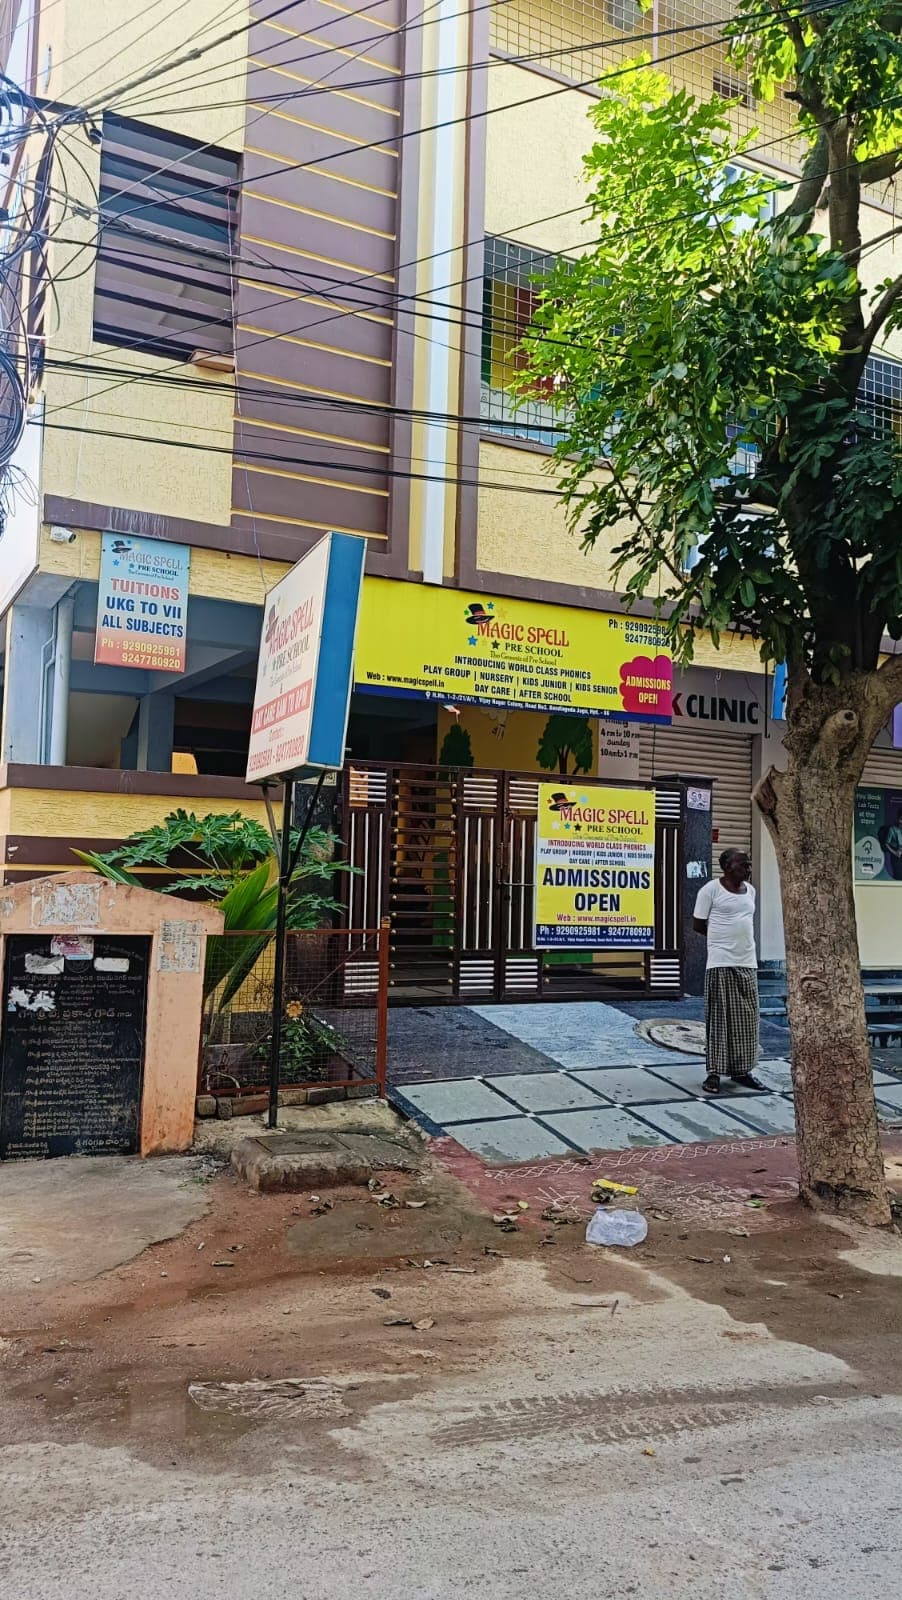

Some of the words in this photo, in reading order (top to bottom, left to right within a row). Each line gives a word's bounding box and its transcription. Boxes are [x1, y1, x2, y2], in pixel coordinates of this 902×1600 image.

[119, 551, 152, 565] MAGIC
[153, 556, 182, 570] SPELL
[138, 564, 151, 572] PRE
[152, 566, 179, 577] SCHOOL
[111, 578, 180, 601] TUITIONS
[106, 596, 135, 612] UKG
[140, 601, 158, 616] TO
[163, 604, 182, 619] VII
[102, 614, 122, 629] ALL
[126, 617, 184, 638] SUBJECTS
[608, 619, 618, 629] Ph
[477, 621, 524, 642] MAGIC
[527, 626, 570, 647] SPELL
[102, 638, 114, 649] Ph
[122, 640, 181, 657] 9290925981
[505, 642, 523, 653] PRE
[525, 645, 564, 658] SCHOOL
[122, 652, 181, 669] 9247780920
[454, 656, 506, 670] INTRODUCING
[508, 662, 534, 674] WORLD
[535, 666, 558, 676] CLASS
[560, 669, 592, 680] PHONICS
[366, 671, 381, 681] Web
[386, 674, 445, 689] www.magicspell.in
[423, 664, 442, 675] PLAY
[444, 667, 471, 679] GROUP
[479, 672, 514, 684] NURSERY
[522, 677, 539, 687] KIDS
[541, 679, 567, 690] JUNIOR
[575, 682, 591, 692] KIDS
[593, 685, 618, 695] SENIOR
[626, 675, 671, 691] ADMISSIONS
[474, 684, 489, 693] DAY
[491, 686, 511, 696] CARE
[519, 689, 541, 699] AFTER
[544, 691, 572, 703] SCHOOL
[638, 692, 658, 704] OPEN
[686, 693, 759, 725] CLINIC
[560, 807, 605, 823] MAGIC
[608, 809, 648, 826] SPELL
[587, 824, 604, 833] PRE
[606, 826, 643, 836] SCHOOL
[548, 839, 585, 848] INTRODUCING
[586, 841, 605, 849] WORLD
[606, 842, 622, 850] CLASS
[624, 843, 646, 851] PHONICS
[572, 849, 592, 857] NURSERY
[597, 850, 606, 858] KIDS
[627, 851, 637, 859] KIDS
[637, 852, 653, 860] SENIOR
[542, 867, 651, 890] ADMISSIONS
[574, 892, 620, 912] OPEN
[556, 913, 571, 922] Web
[577, 915, 637, 924] www.magicspell.in
[539, 925, 549, 936] Ph
[555, 925, 601, 936] 9290925981
[607, 926, 651, 937] 9247780920
